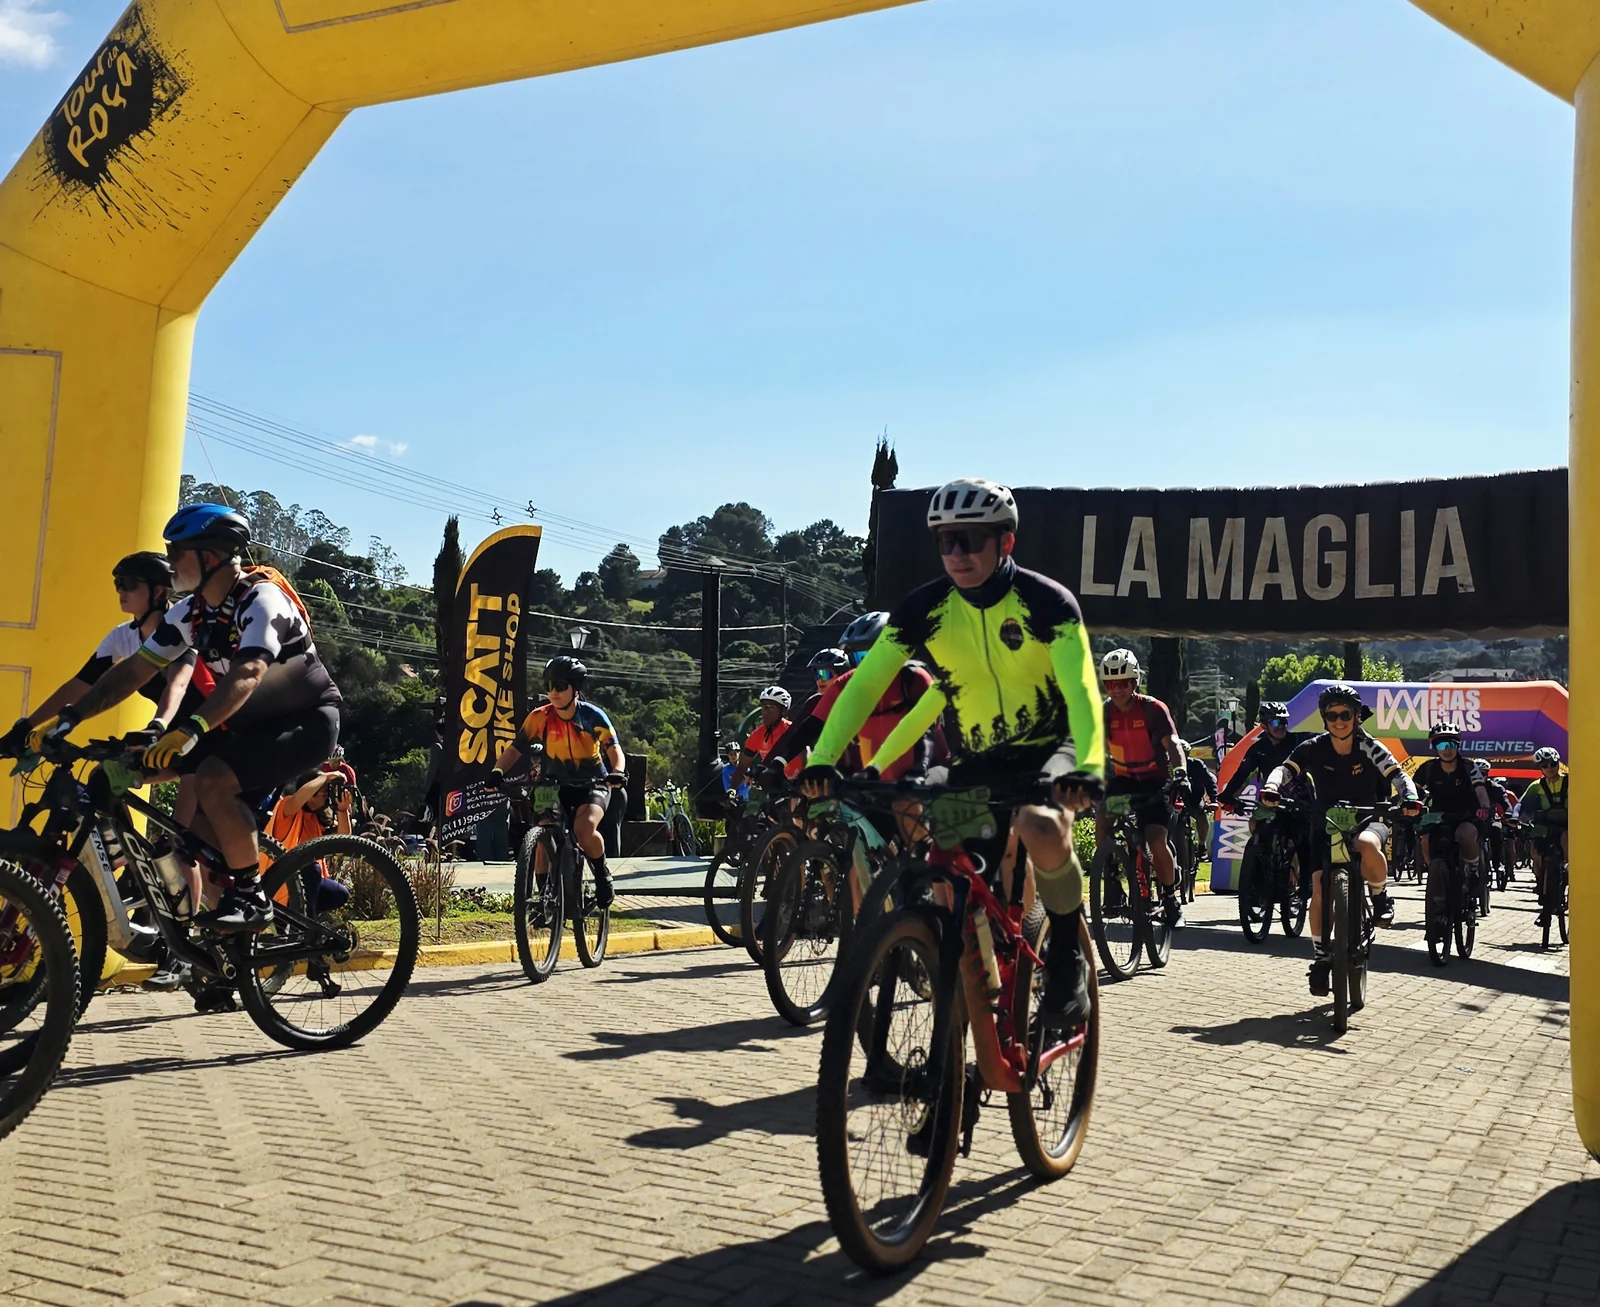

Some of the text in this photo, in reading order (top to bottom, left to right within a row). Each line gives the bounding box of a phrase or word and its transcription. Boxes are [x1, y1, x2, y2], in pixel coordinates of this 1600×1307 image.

[1080, 505, 1475, 602] LA MAGLIA
[458, 582, 503, 765] SCATT
[502, 592, 521, 682] SHOP
[122, 831, 174, 920] OGGI
